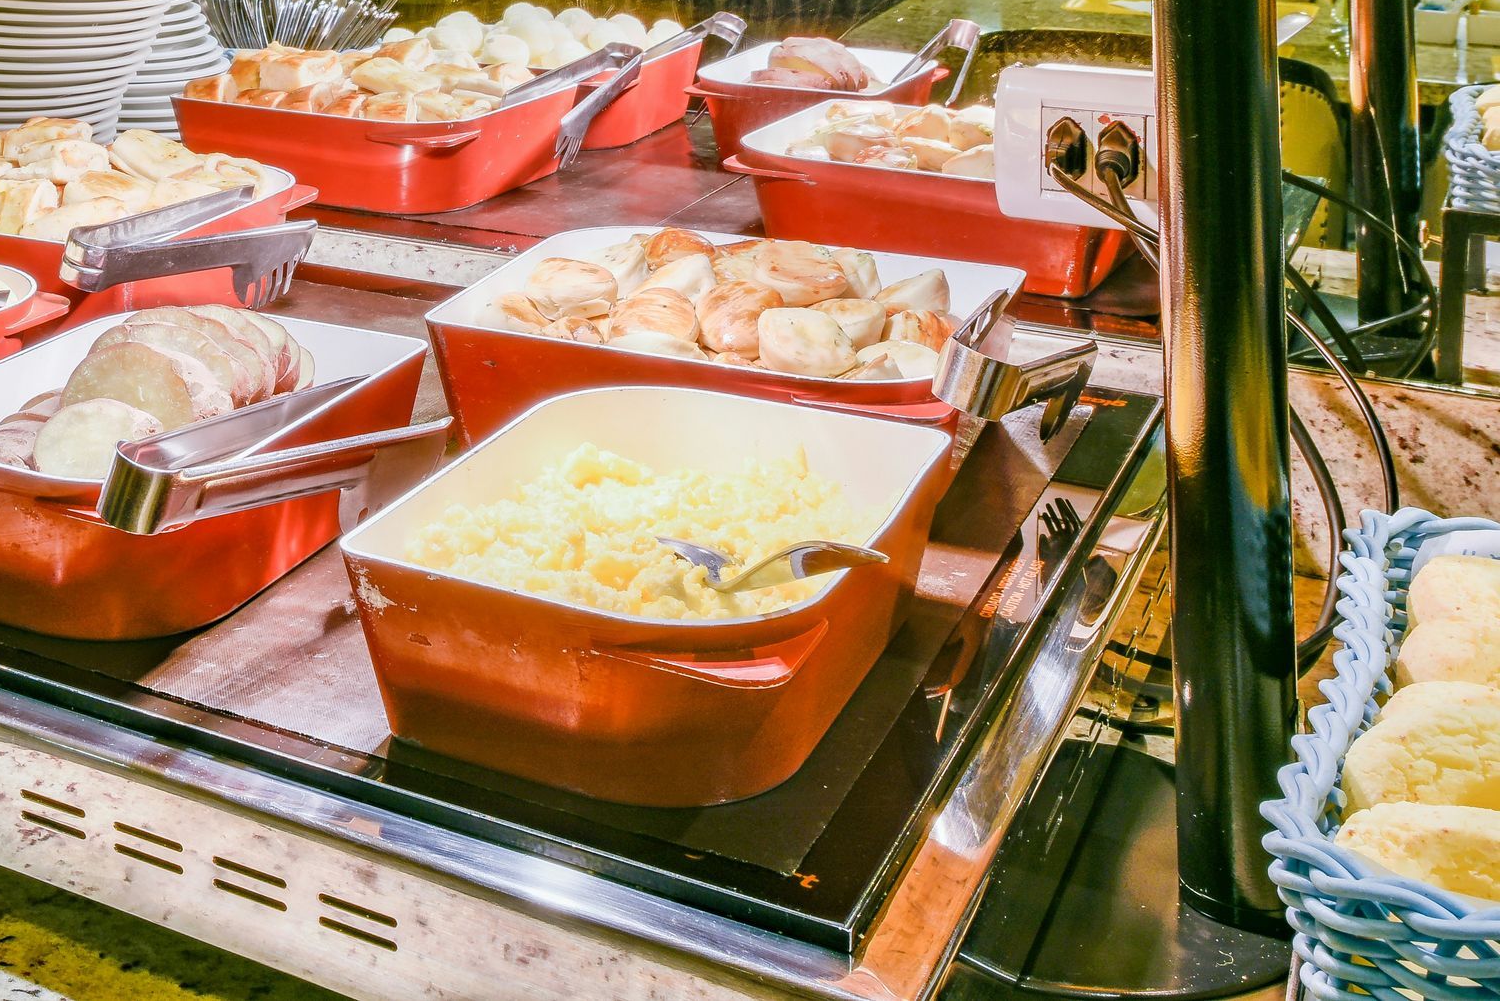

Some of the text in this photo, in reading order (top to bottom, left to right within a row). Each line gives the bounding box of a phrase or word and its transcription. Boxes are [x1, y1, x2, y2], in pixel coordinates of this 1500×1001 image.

[1025, 559, 1045, 578] GLASS
[1017, 576, 1034, 590] HOT
[979, 592, 1005, 618] CUIDADO
[1000, 591, 1025, 618] CAUTION
